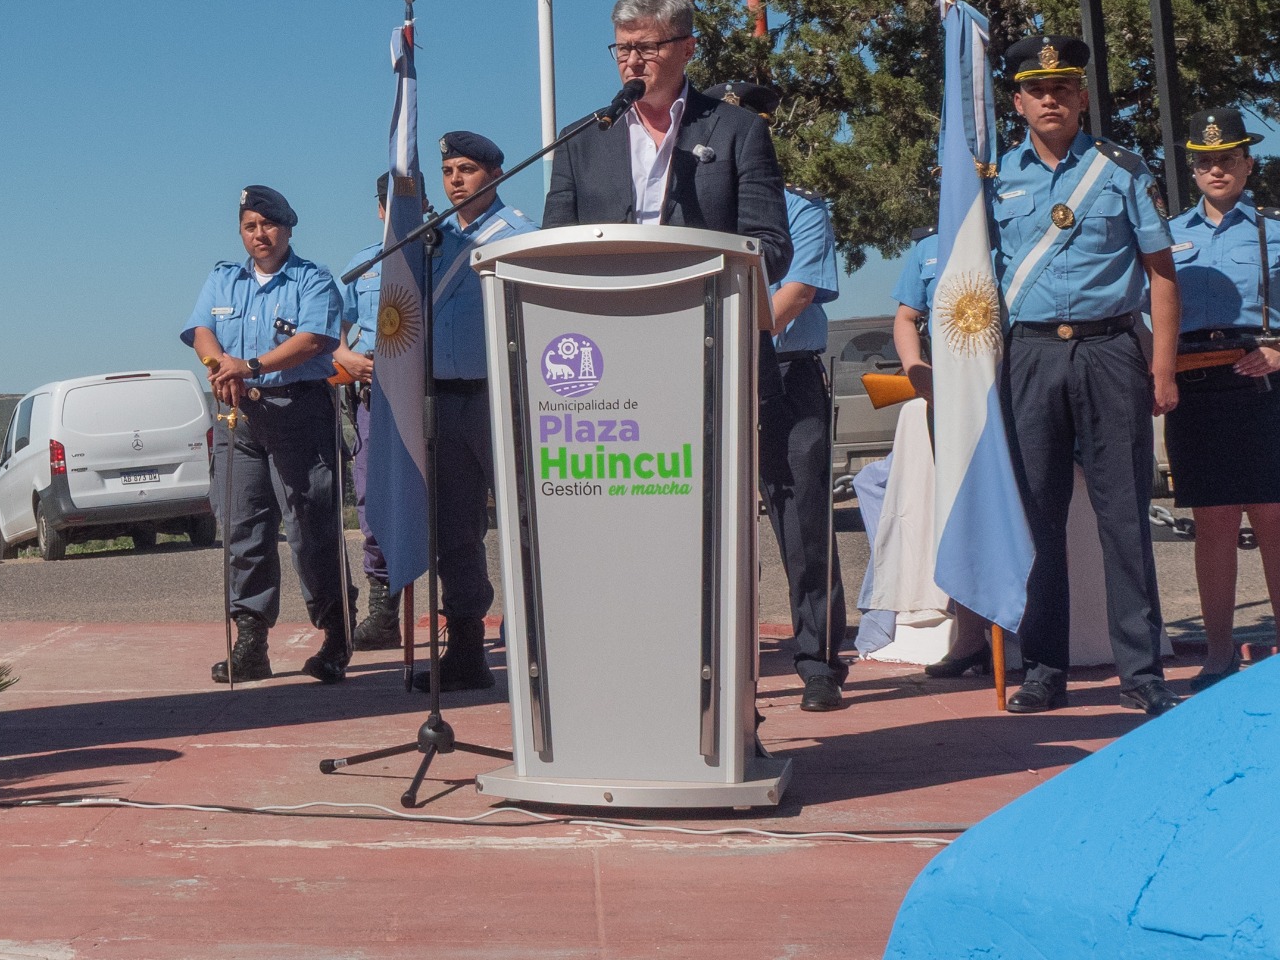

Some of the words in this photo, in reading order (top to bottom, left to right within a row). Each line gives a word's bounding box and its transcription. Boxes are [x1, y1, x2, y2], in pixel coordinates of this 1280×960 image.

[539, 400, 620, 413] Municipalidad
[624, 399, 638, 409] de
[539, 414, 639, 443] Plaza
[541, 444, 692, 479] Huincul
[542, 482, 602, 495] Gestión
[608, 484, 628, 495] en
[631, 481, 692, 495] marcha
